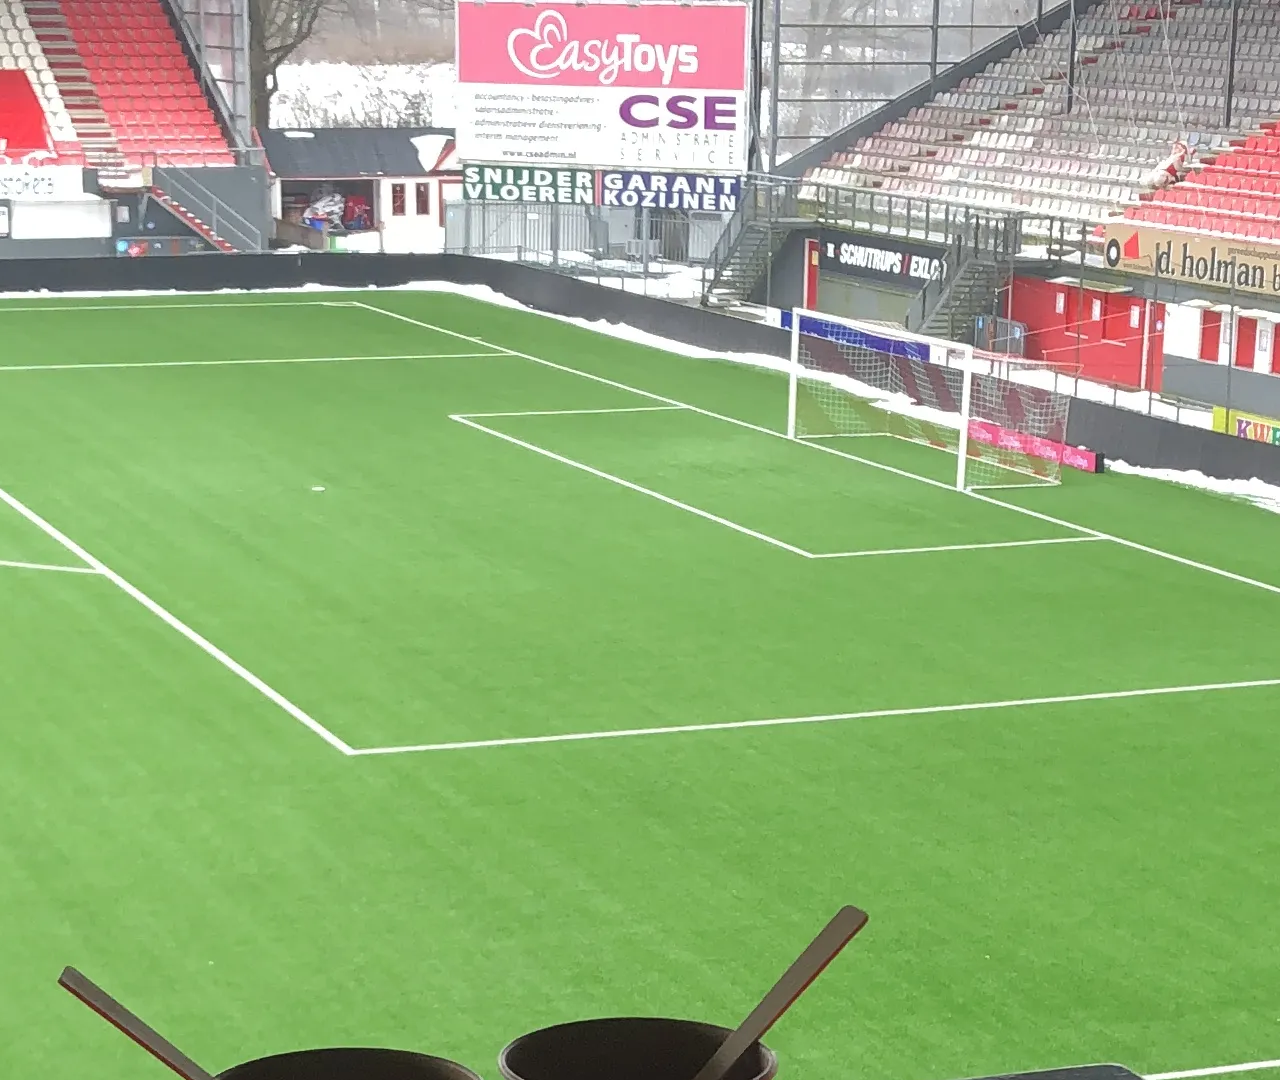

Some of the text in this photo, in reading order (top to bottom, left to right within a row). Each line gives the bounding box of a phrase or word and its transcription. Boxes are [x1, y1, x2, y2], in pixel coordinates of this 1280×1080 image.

[508, 9, 698, 84] EasyToys
[619, 95, 736, 130] CSE
[620, 147, 734, 165] SERVICE
[464, 167, 593, 188] SNIJDER
[604, 174, 737, 195] GARANT
[463, 183, 593, 204] VLOEREN
[604, 189, 736, 211] KOZIJNEN
[839, 243, 902, 274] SCHUTRUPS
[1158, 240, 1176, 276] d.
[1181, 243, 1265, 290] holman
